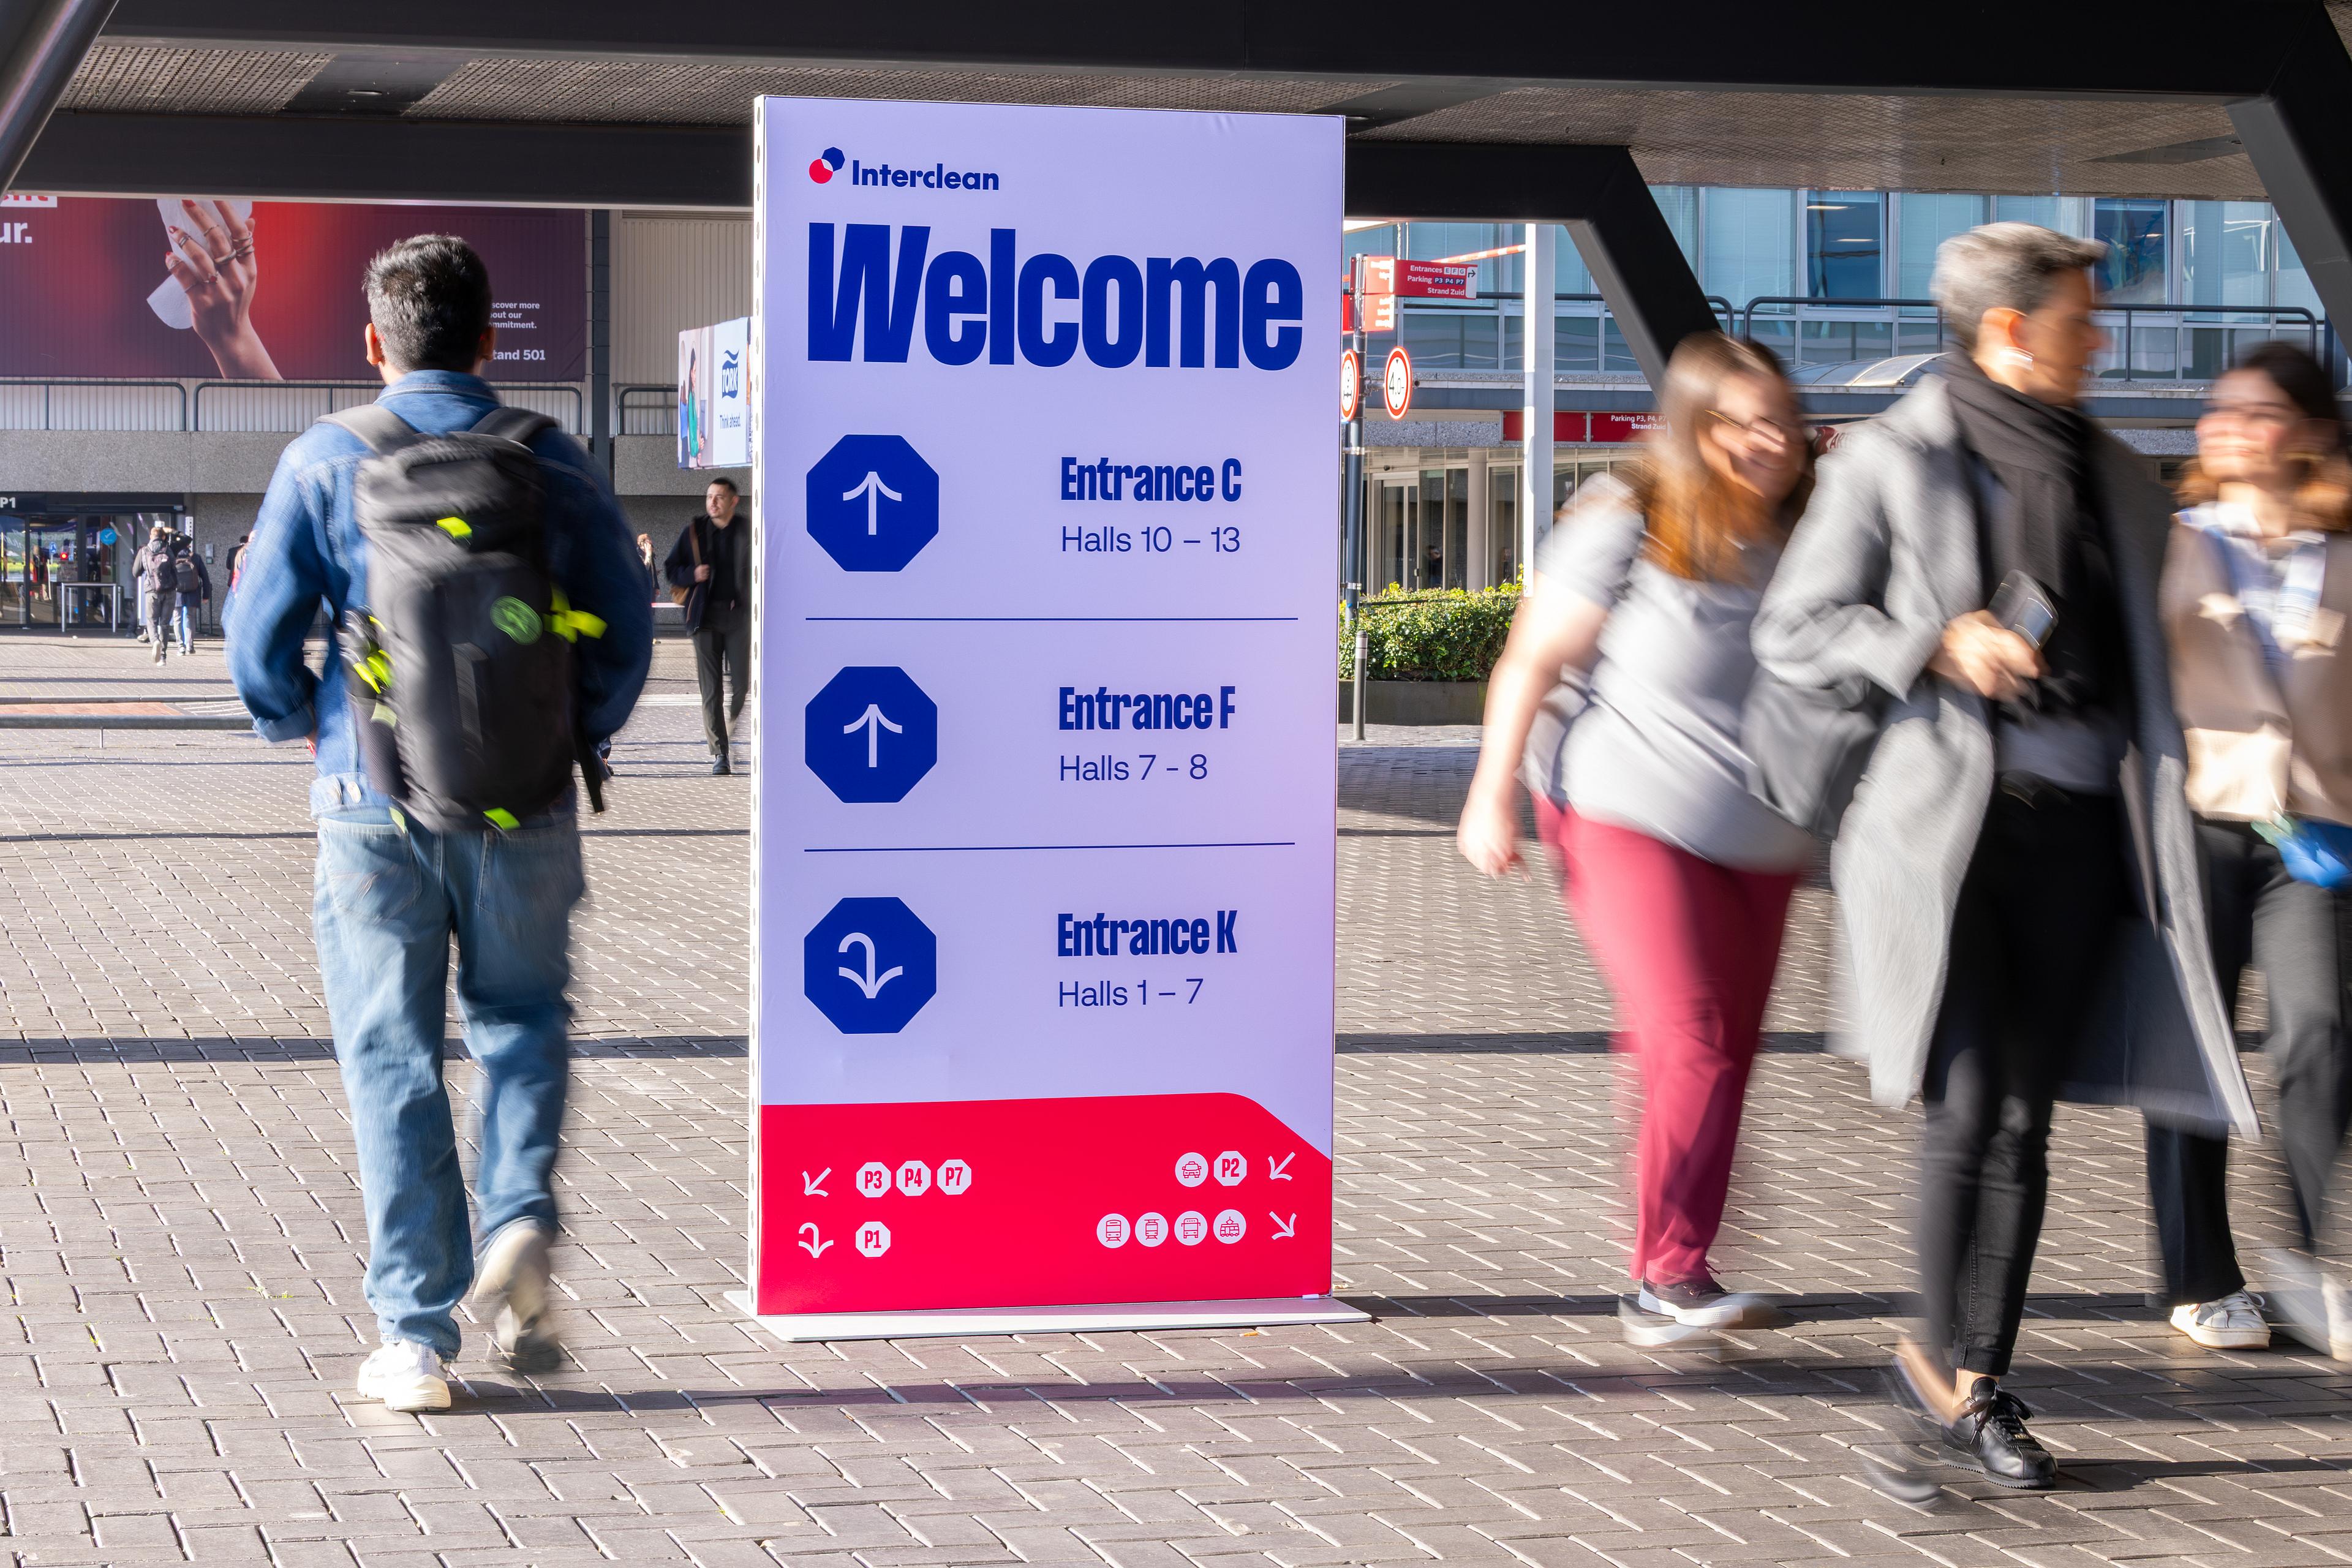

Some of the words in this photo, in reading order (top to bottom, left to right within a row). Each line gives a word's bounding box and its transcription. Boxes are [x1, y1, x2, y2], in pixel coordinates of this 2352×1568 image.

[852, 159, 999, 190] Interclean
[1407, 275, 1432, 284] Parking
[807, 222, 1303, 371] Welcome
[492, 349, 520, 360] tand
[523, 349, 546, 360] 501
[722, 367, 738, 393] TORK
[720, 413, 729, 429] Think
[1061, 456, 1215, 502] Entrance
[1221, 458, 1242, 502] C
[0, 497, 16, 508] P1
[1062, 526, 1131, 552] Halls
[1140, 526, 1172, 552] 10
[1210, 526, 1240, 552] 13
[1058, 687, 1213, 730] Entrance
[1219, 685, 1235, 729] F
[1060, 755, 1129, 781] Halls
[1139, 754, 1156, 780] 7
[1189, 753, 1208, 780] 8
[1057, 913, 1210, 957] Entrance
[1216, 910, 1238, 954] K
[1059, 980, 1128, 1008] Halls
[1137, 979, 1147, 1005] 1
[1186, 978, 1204, 1004] 7
[864, 1170, 883, 1189] P3
[905, 1167, 922, 1188] P4
[945, 1166, 963, 1186] P7
[1221, 1158, 1240, 1178] P2
[864, 1230, 881, 1249] P1
